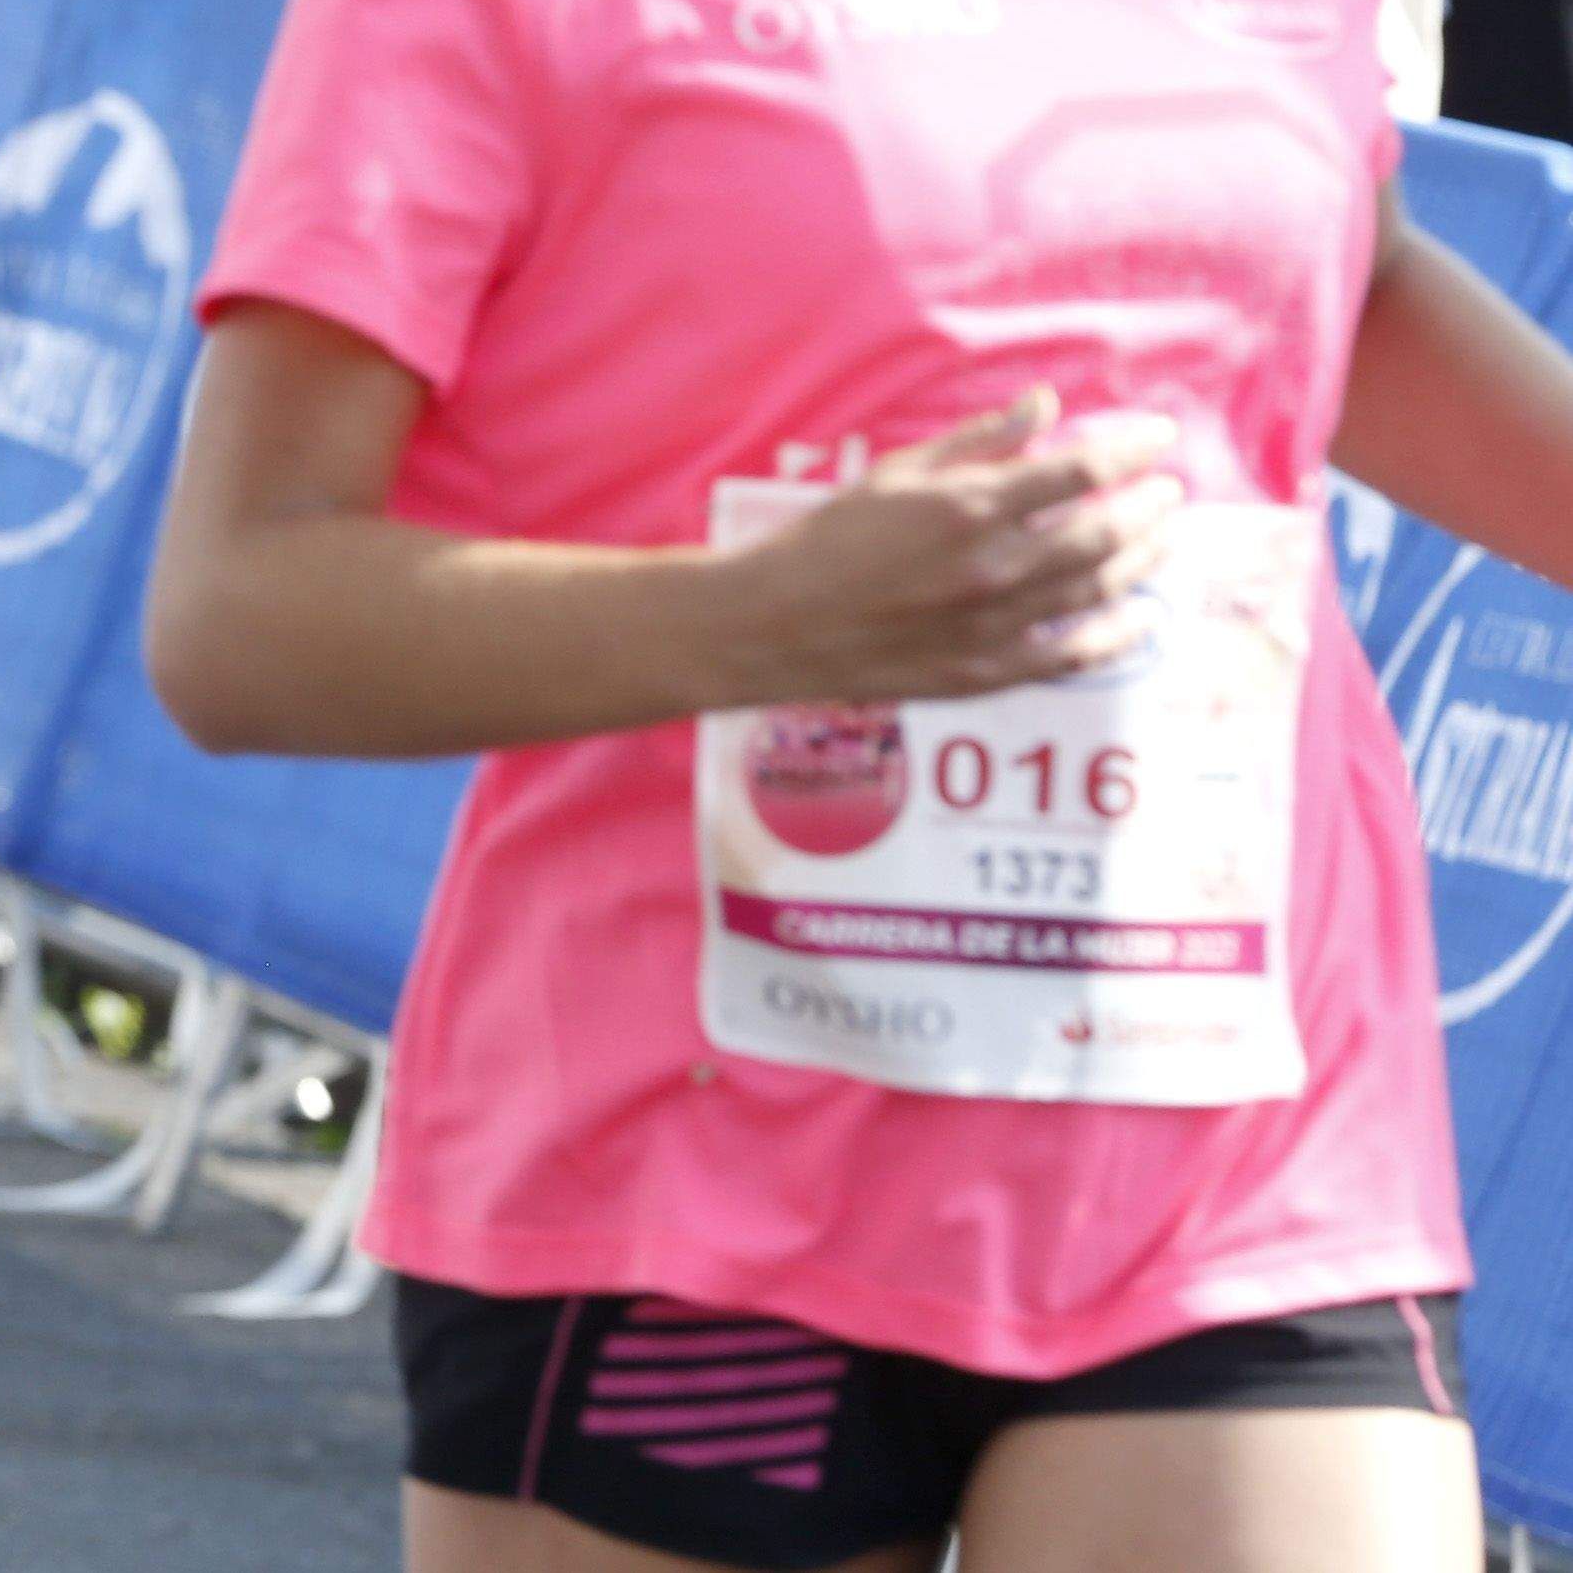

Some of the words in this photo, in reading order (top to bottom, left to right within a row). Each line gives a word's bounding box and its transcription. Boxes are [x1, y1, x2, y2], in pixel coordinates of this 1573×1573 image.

[933, 735, 1140, 820] 016
[972, 849, 1102, 902] 1373
[773, 908, 952, 953] CARRERA
[959, 921, 1010, 958] DE
[1017, 926, 1069, 961] LA
[762, 977, 955, 1038] OYSHO
